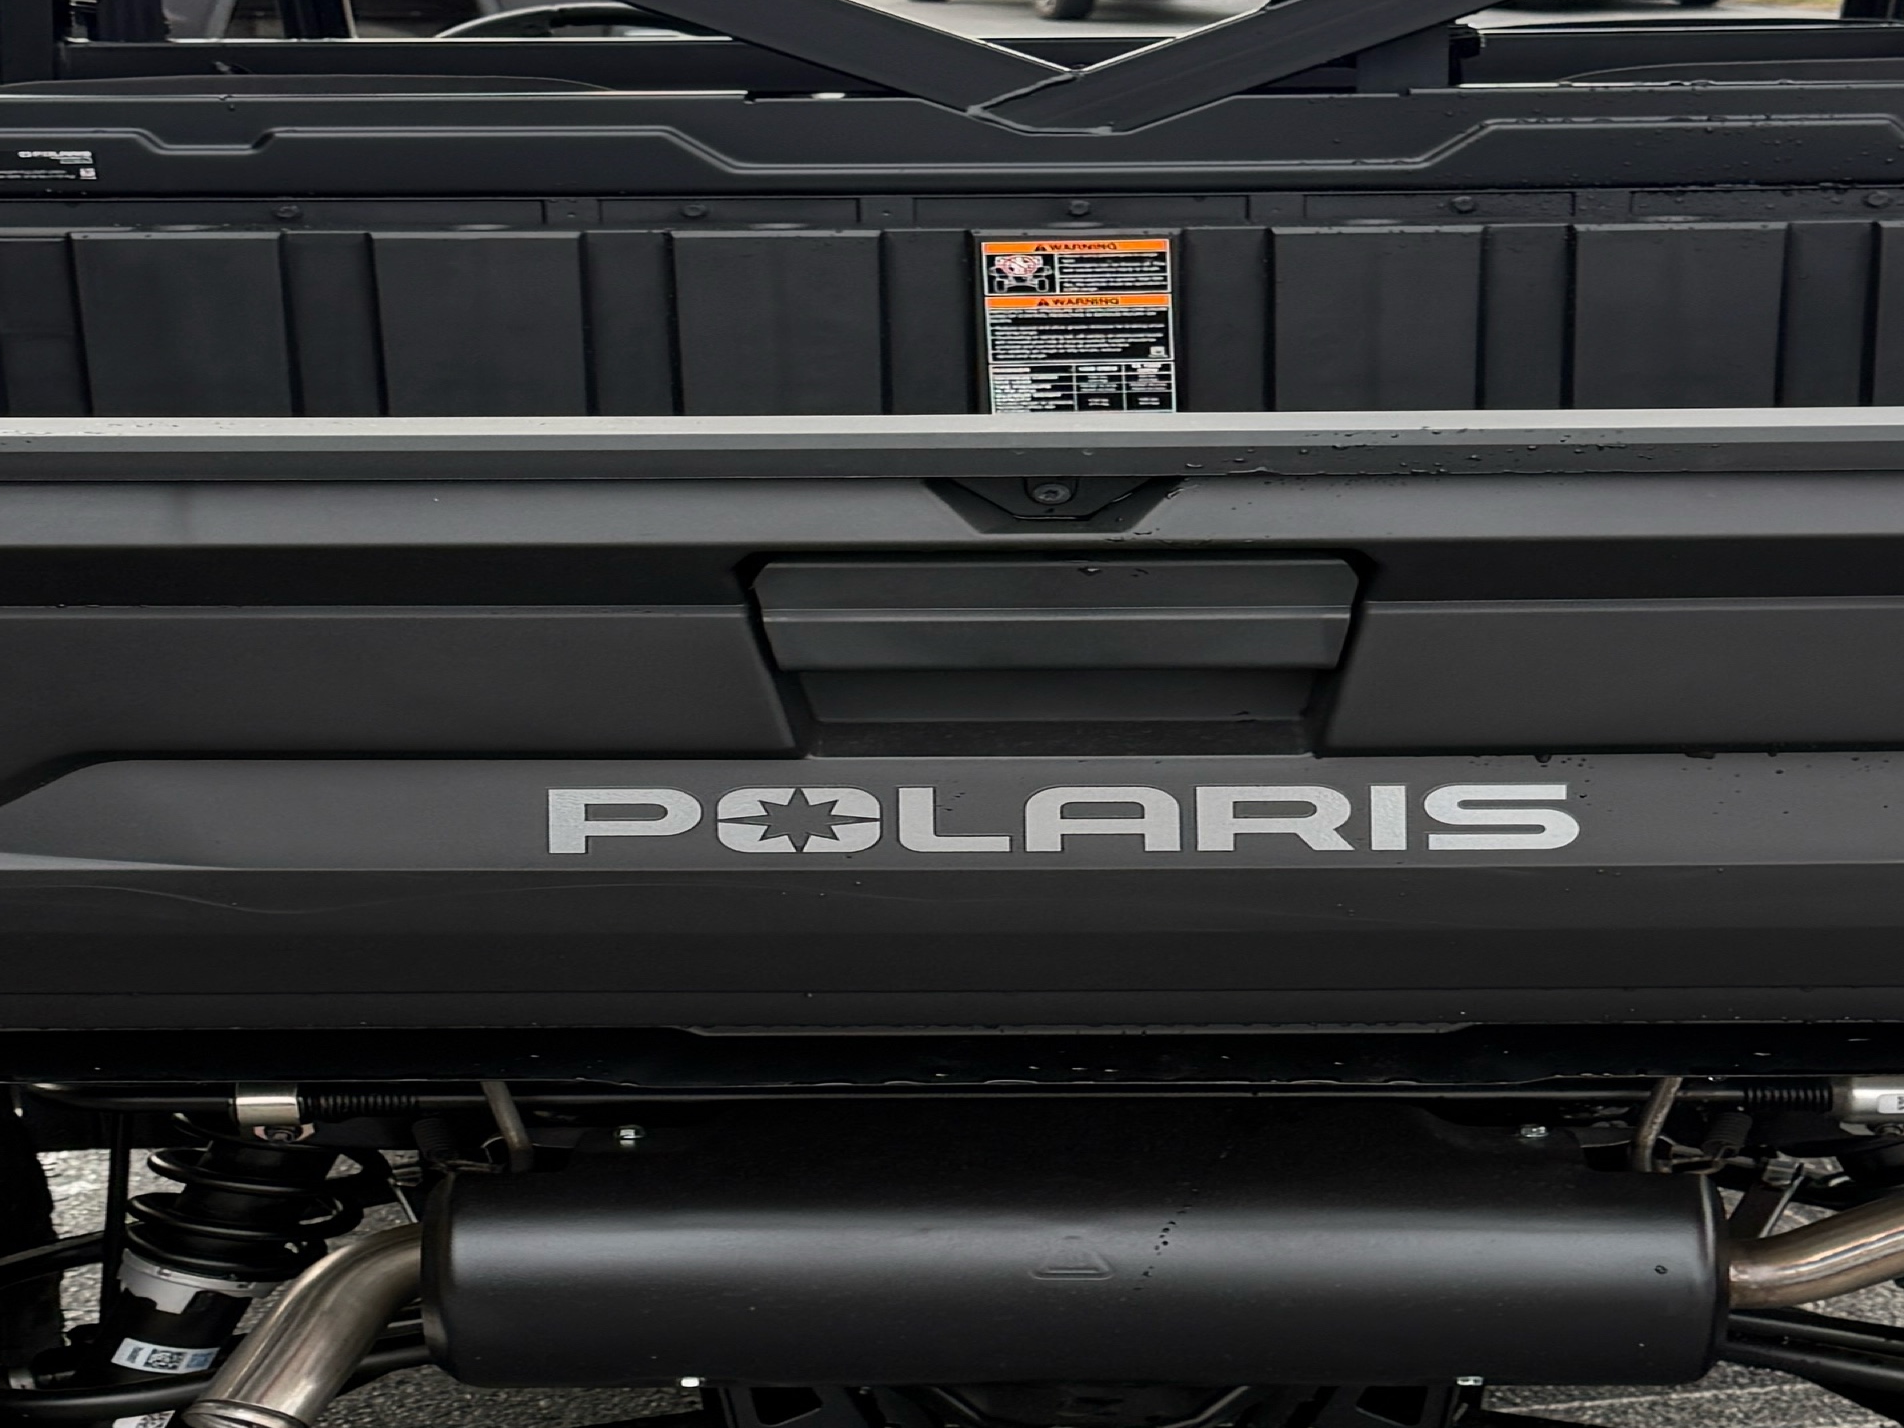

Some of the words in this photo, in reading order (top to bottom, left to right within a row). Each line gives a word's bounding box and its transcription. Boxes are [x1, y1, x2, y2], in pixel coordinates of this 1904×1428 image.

[1049, 242, 1118, 251] WARNING
[1051, 297, 1119, 306] WARNING
[548, 784, 1580, 854] POLARIS
